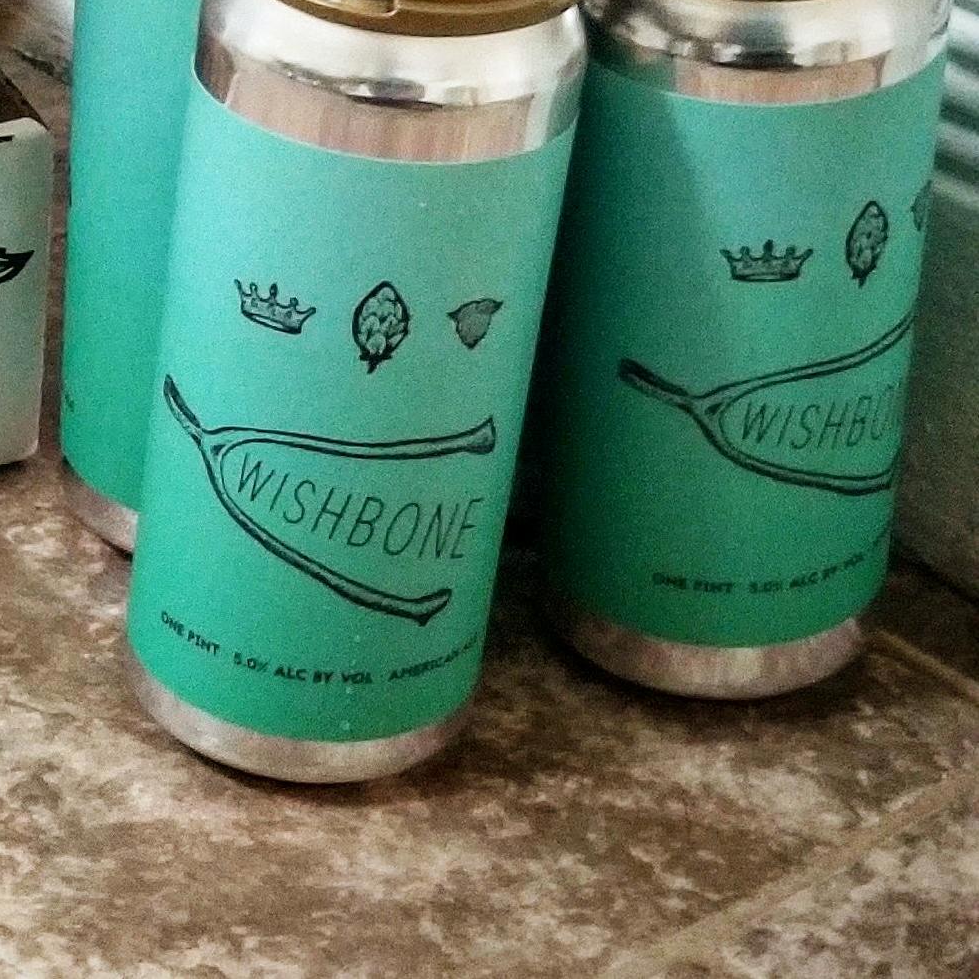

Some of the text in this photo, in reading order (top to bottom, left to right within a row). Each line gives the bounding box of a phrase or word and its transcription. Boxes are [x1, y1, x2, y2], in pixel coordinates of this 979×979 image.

[237, 453, 486, 560] WISHBONE
[160, 610, 185, 637] ONE
[186, 630, 220, 656] PINT
[273, 663, 309, 682] ALC
[312, 670, 334, 685] BY
